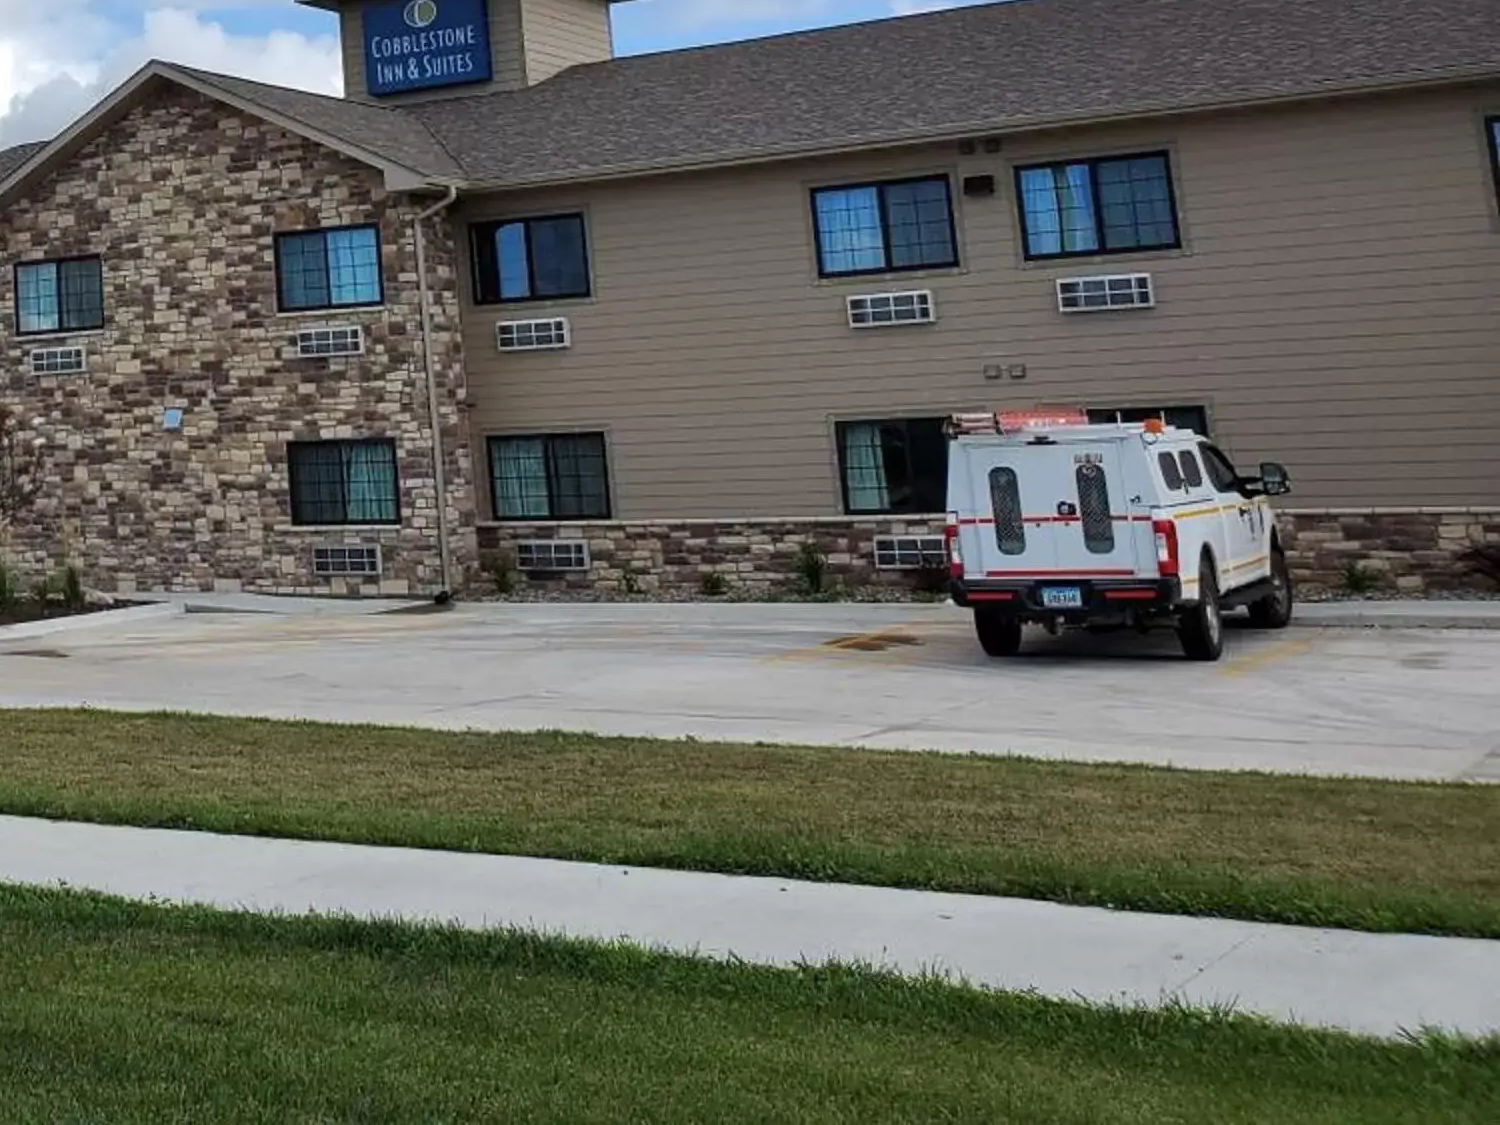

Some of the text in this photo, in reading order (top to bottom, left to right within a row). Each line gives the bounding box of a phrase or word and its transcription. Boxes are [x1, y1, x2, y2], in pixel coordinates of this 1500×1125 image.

[371, 25, 476, 58] COBBLESTONE
[377, 52, 474, 84] INN & SUITES
